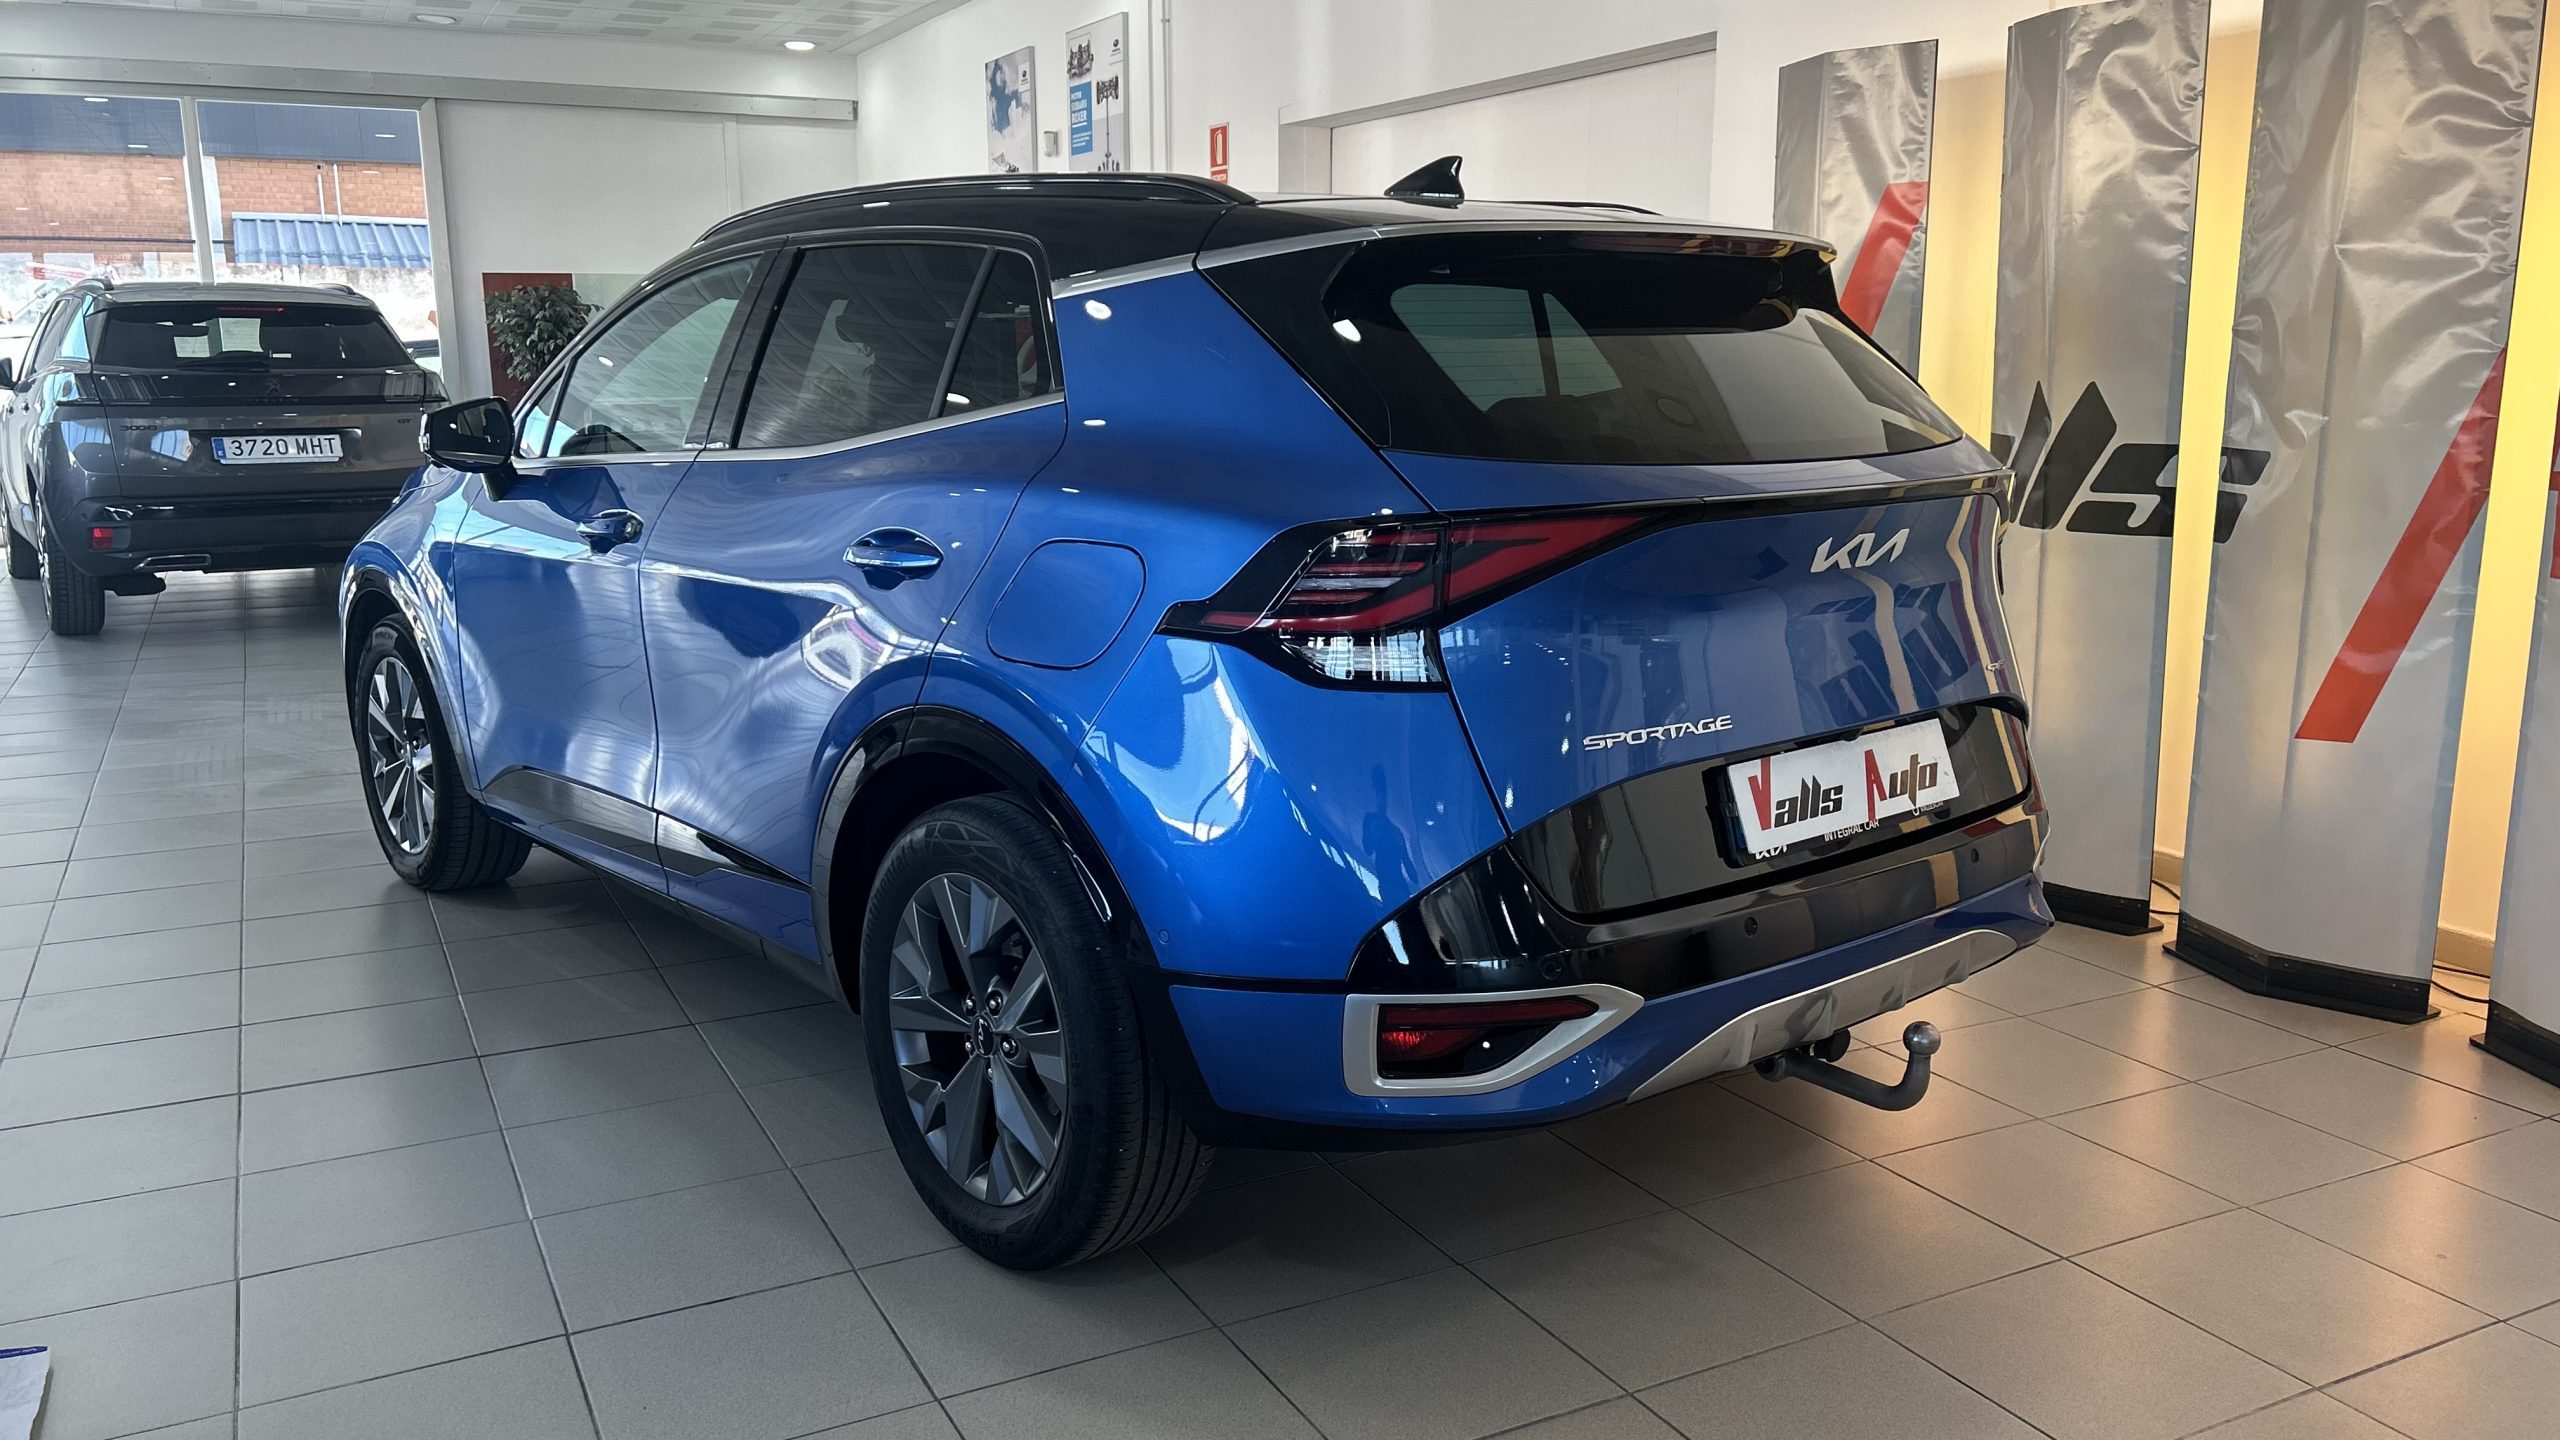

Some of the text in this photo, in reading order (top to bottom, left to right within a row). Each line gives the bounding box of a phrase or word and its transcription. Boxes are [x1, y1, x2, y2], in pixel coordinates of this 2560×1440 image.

[231, 437, 335, 456] 3720 MHT
[1809, 528, 1910, 573] KIA
[1583, 714, 1733, 751] SPORTAGE
[1748, 749, 1939, 831] Valls Auto
[1824, 819, 1880, 843] INTEGRAL CAR
